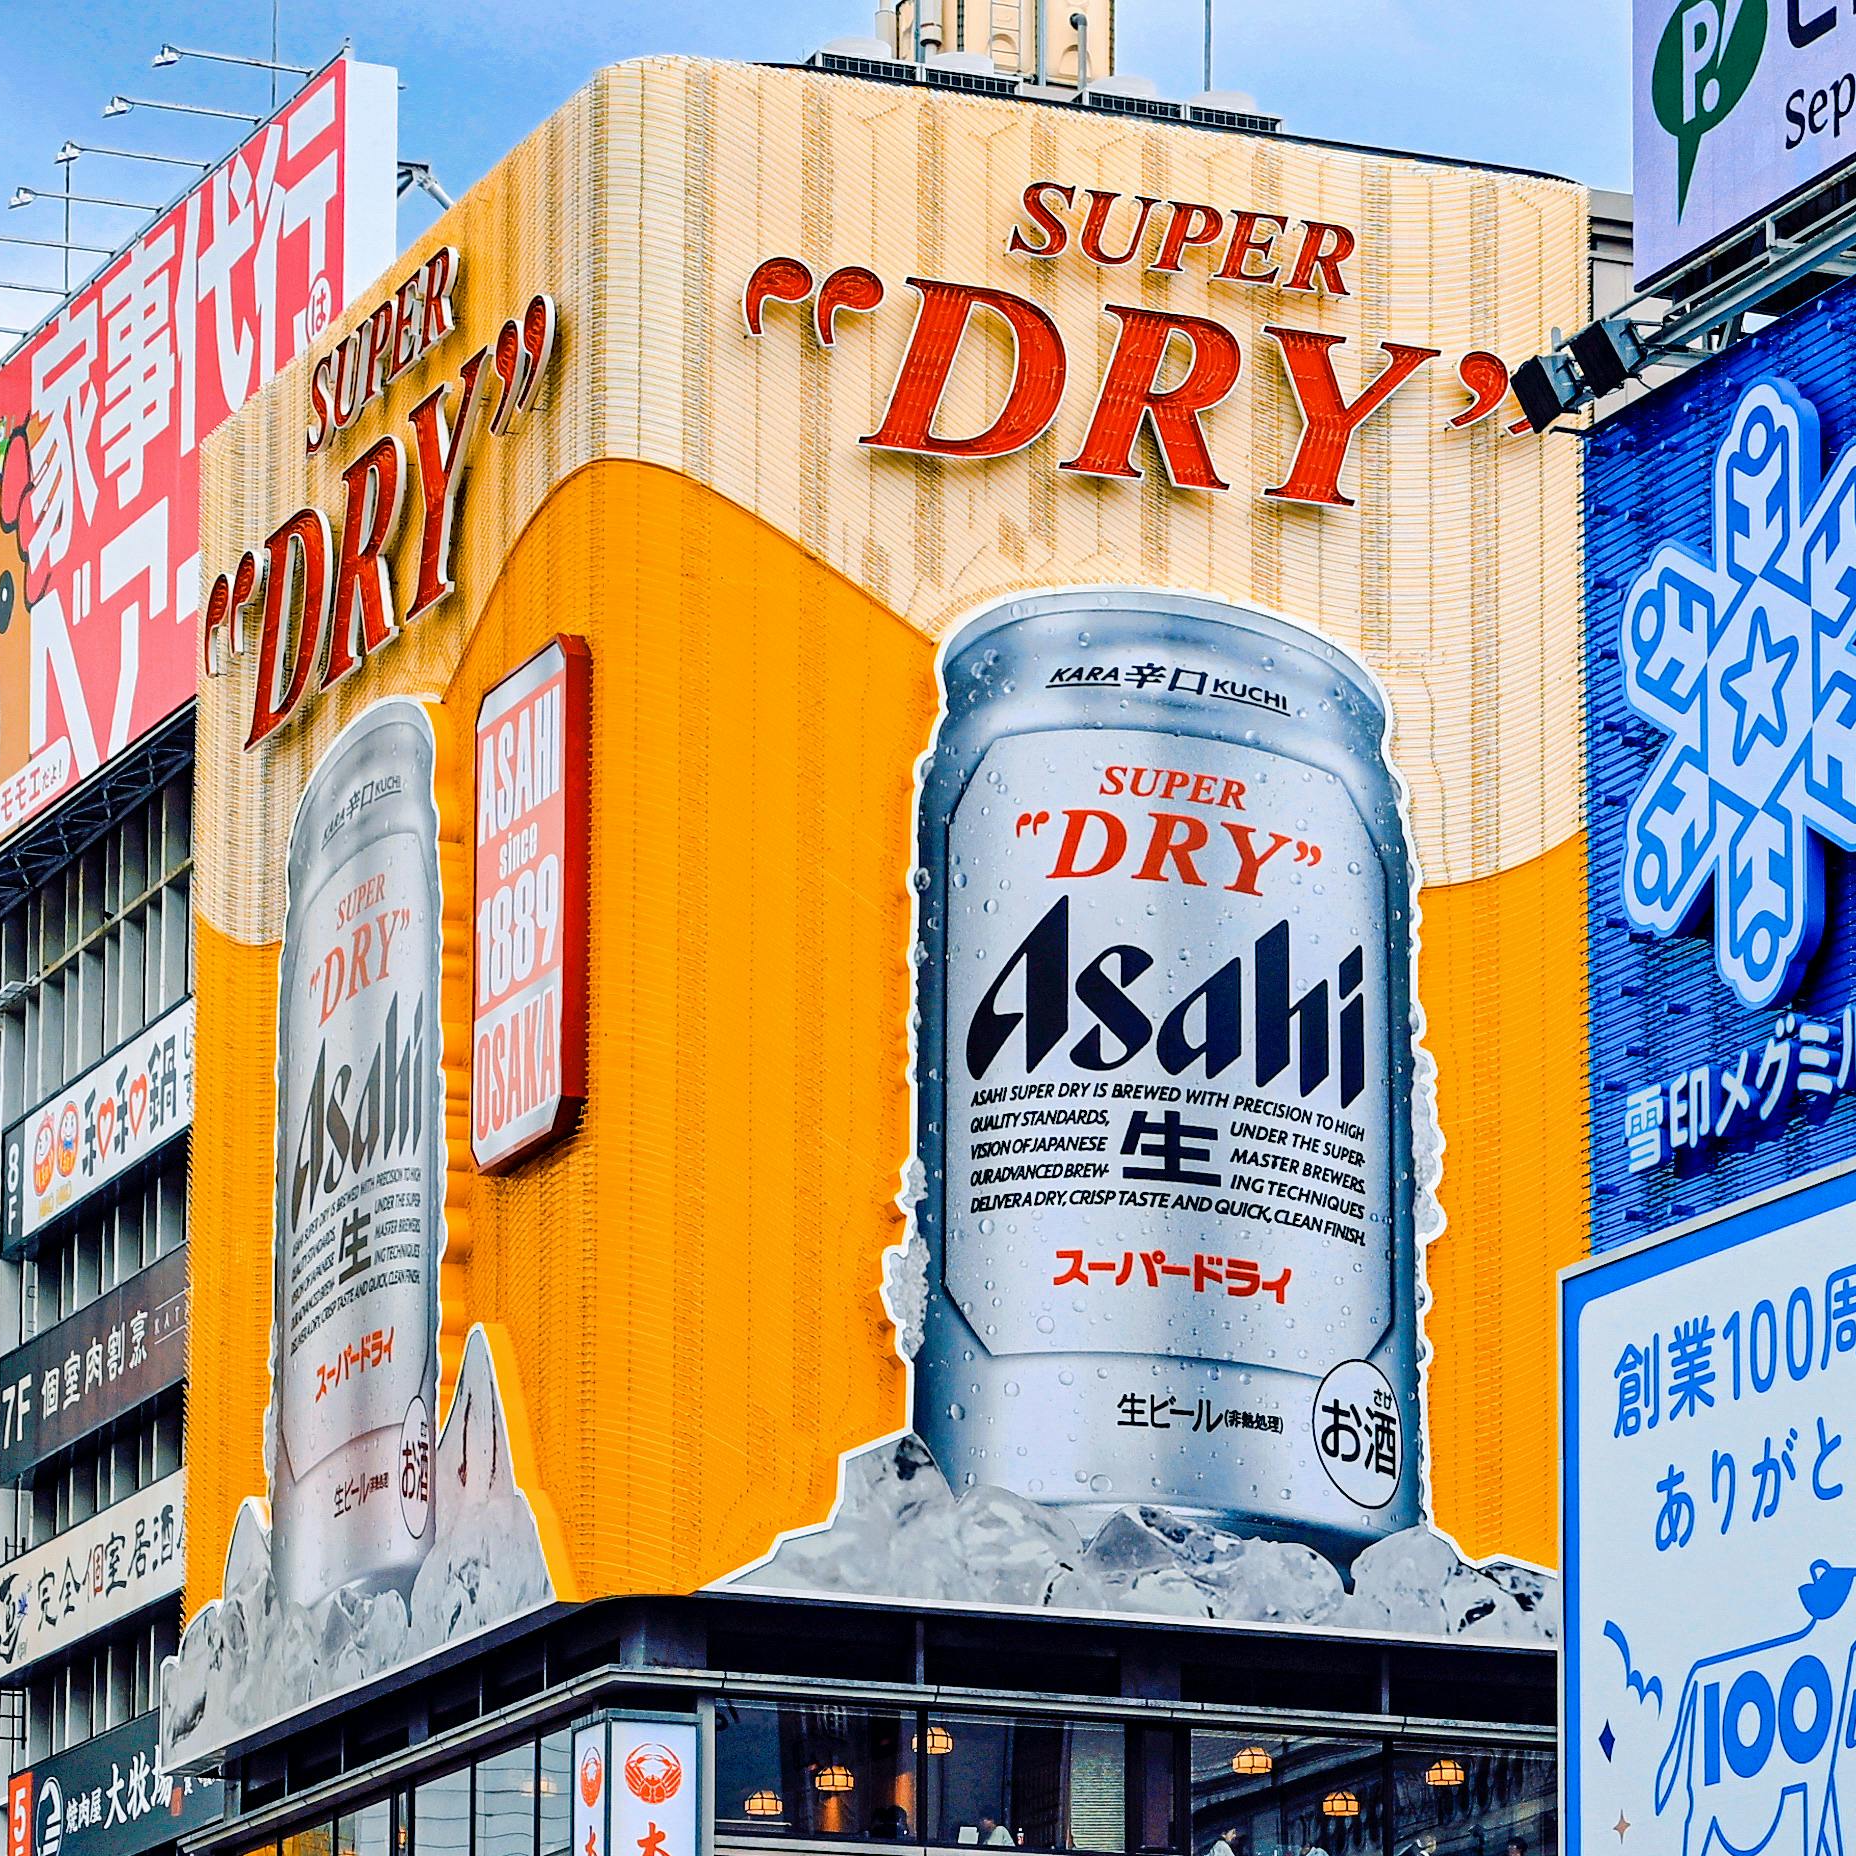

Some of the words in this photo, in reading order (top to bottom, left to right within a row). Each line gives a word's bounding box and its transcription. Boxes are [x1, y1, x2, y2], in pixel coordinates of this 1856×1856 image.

[1007, 178, 1357, 297] SUPER
[307, 246, 457, 457] SUPER
[30, 496, 200, 781] ベア
[1049, 666, 1119, 686] KARA
[1124, 662, 1208, 693] 辛口
[1213, 678, 1288, 710] KUCHI
[478, 685, 561, 846] ASAHI
[1099, 765, 1246, 810] SUPER
[499, 821, 537, 878] since
[336, 874, 386, 931] SUPER
[478, 854, 560, 1008] 1889
[965, 894, 1363, 1109] Asahi
[477, 984, 557, 1142] OSAKA
[292, 991, 423, 1234] Asahi
[971, 1087, 1007, 1107] ASAHI
[1010, 1084, 1054, 1100] SUPER
[1058, 1083, 1091, 1097] DRY
[1093, 1083, 1108, 1097] IS
[1112, 1084, 1181, 1102] BREWED
[1186, 1089, 1229, 1108] WITH
[1233, 1096, 1313, 1124] PRECISION
[1316, 1114, 1333, 1130] TO
[1335, 1119, 1364, 1141] HIGH
[971, 1113, 1021, 1133] QUALITY
[1022, 1110, 1110, 1127] STANDARDS,
[971, 1140, 1011, 1160] VISION
[1012, 1138, 1030, 1154] OF
[1030, 1137, 1108, 1152] JAPANESE
[1120, 1110, 1222, 1187] 生
[1231, 1122, 1288, 1145] UNDER
[1293, 1134, 1320, 1153] THE
[7, 1143, 19, 1235] 8F
[971, 1169, 996, 1186] OUR
[996, 1164, 1063, 1181] ADVANCED
[1230, 1148, 1299, 1174] MASTER
[1231, 1175, 1264, 1193] ING
[1268, 1180, 1365, 1219] TECHNIQUES
[339, 1207, 371, 1285] 生
[971, 1193, 1022, 1213] DELIVER
[1021, 1192, 1033, 1207] A
[1034, 1190, 1067, 1206] DRY,
[1069, 1190, 1116, 1205] CRISP
[1118, 1191, 1171, 1208] TASTE
[1171, 1194, 1212, 1212] AND
[1215, 1199, 1273, 1223] QUICK,
[1274, 1209, 1323, 1232] CLEAN
[1053, 1249, 1291, 1303] スーパードライ
[1, 1374, 33, 1452] 7F
[42, 1310, 148, 1421] 個室肉割烹
[316, 1326, 394, 1402] スーパードライ
[1321, 1399, 1396, 1479] お酒
[37, 1505, 186, 1632] 完全個室居酒
